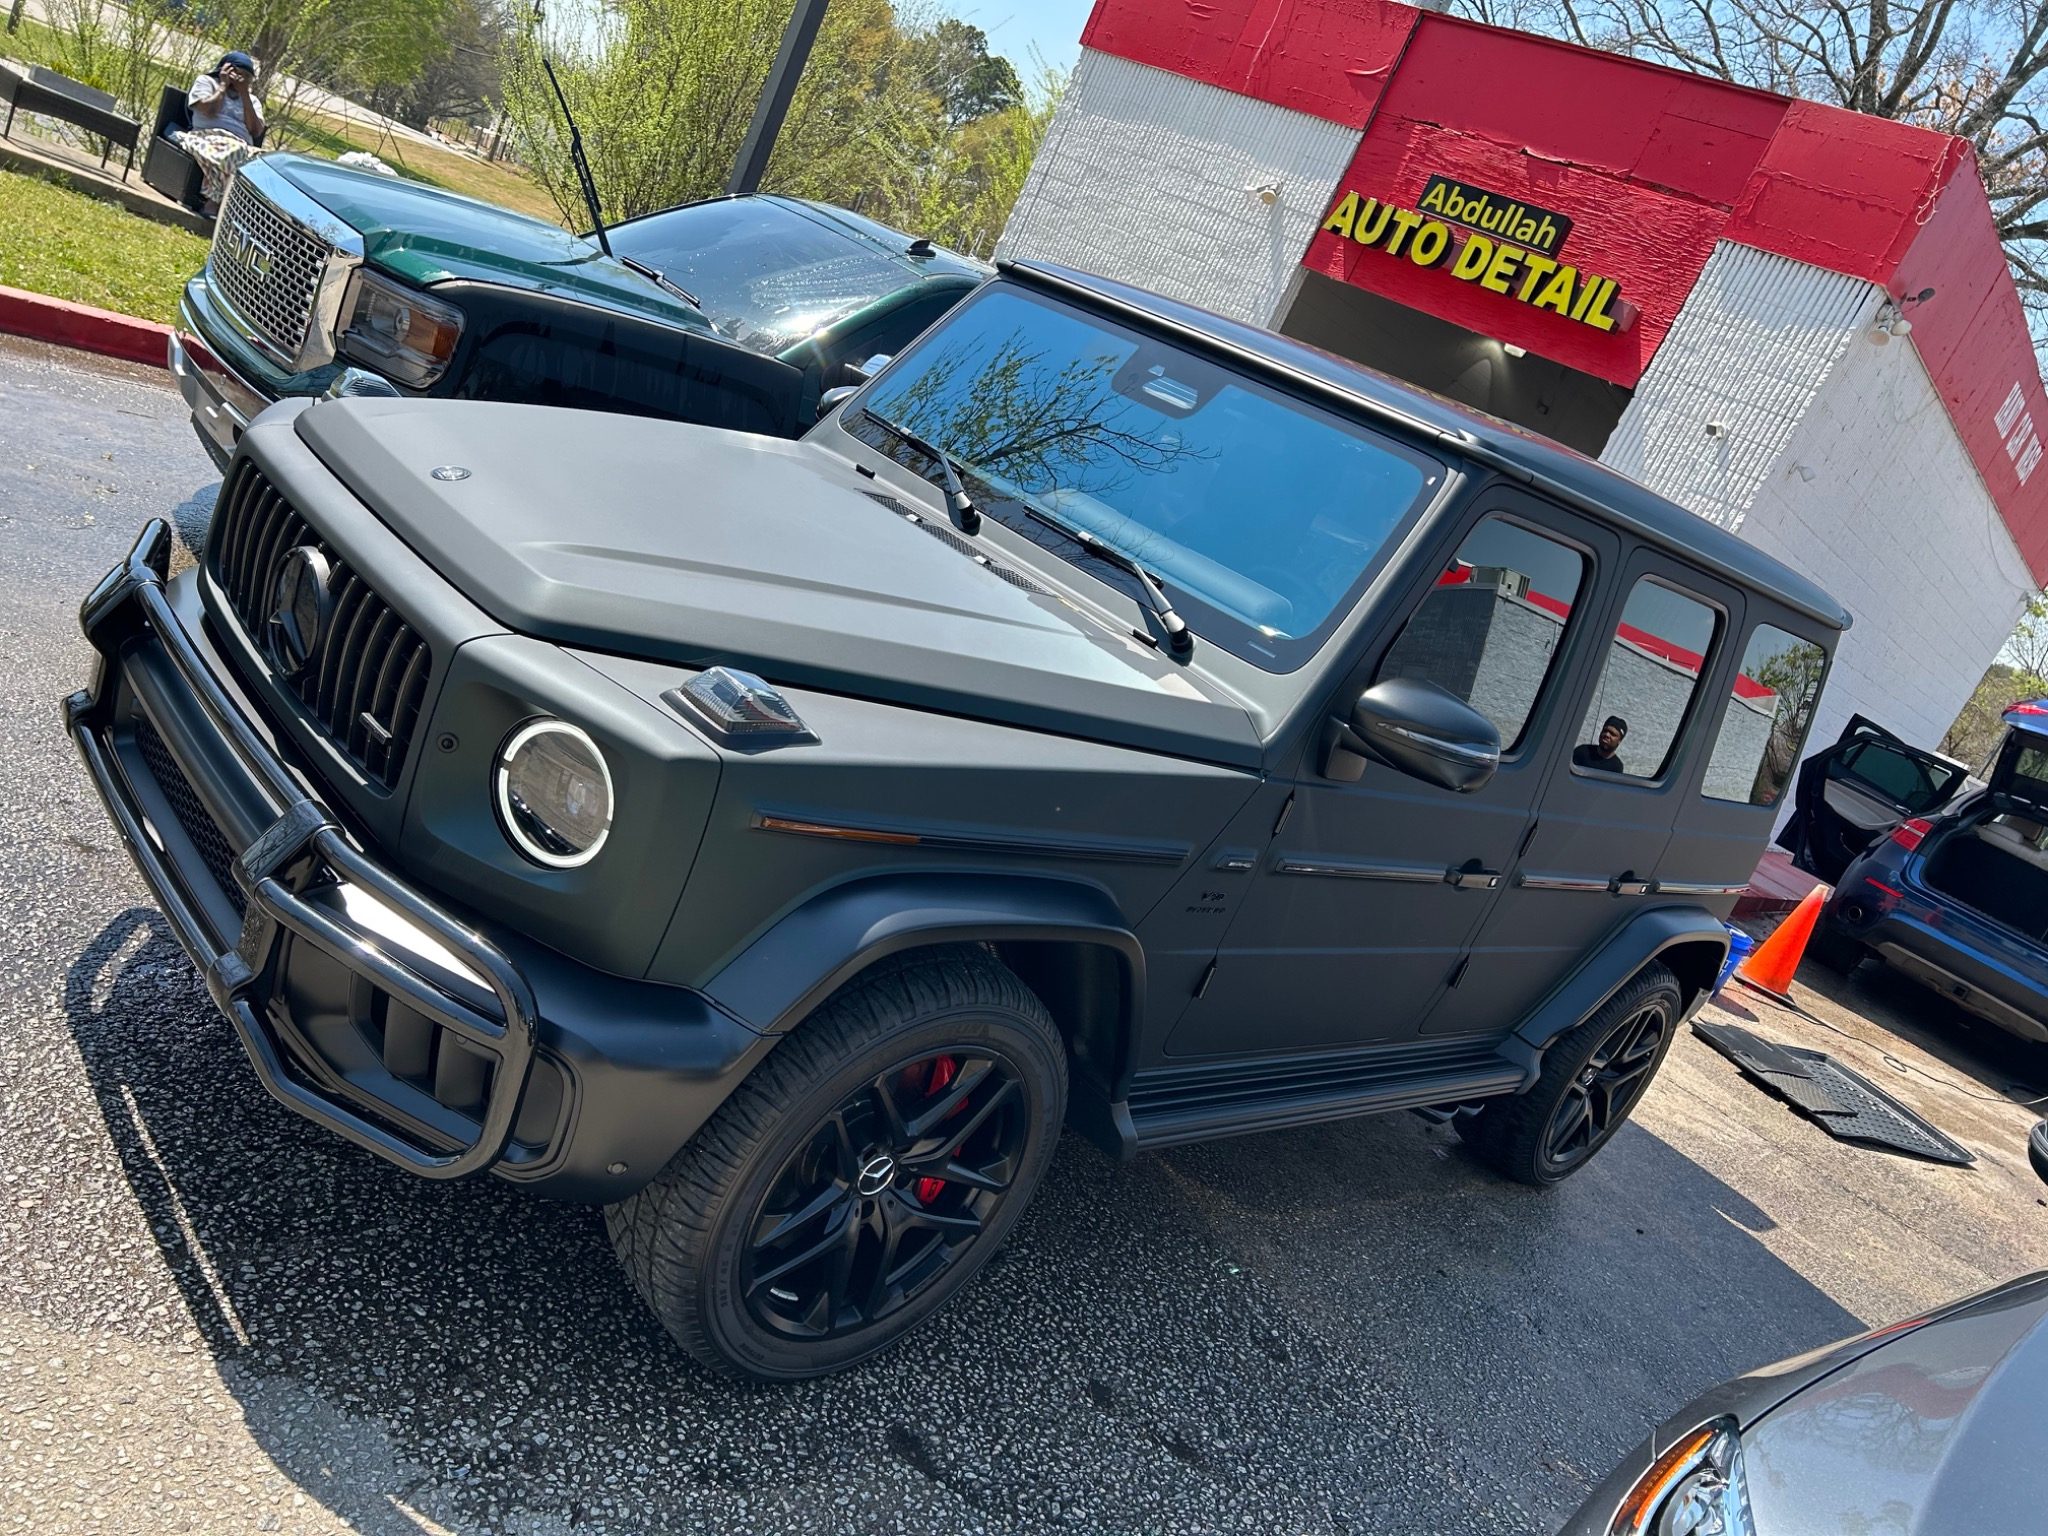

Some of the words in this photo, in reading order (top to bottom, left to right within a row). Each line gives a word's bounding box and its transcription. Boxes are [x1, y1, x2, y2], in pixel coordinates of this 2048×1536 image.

[1420, 182, 1557, 249] Abdullah
[227, 220, 274, 282] GMC
[1322, 190, 1450, 266] AUTO
[1451, 232, 1618, 332] DETAIL
[2005, 411, 2034, 462] CAR
